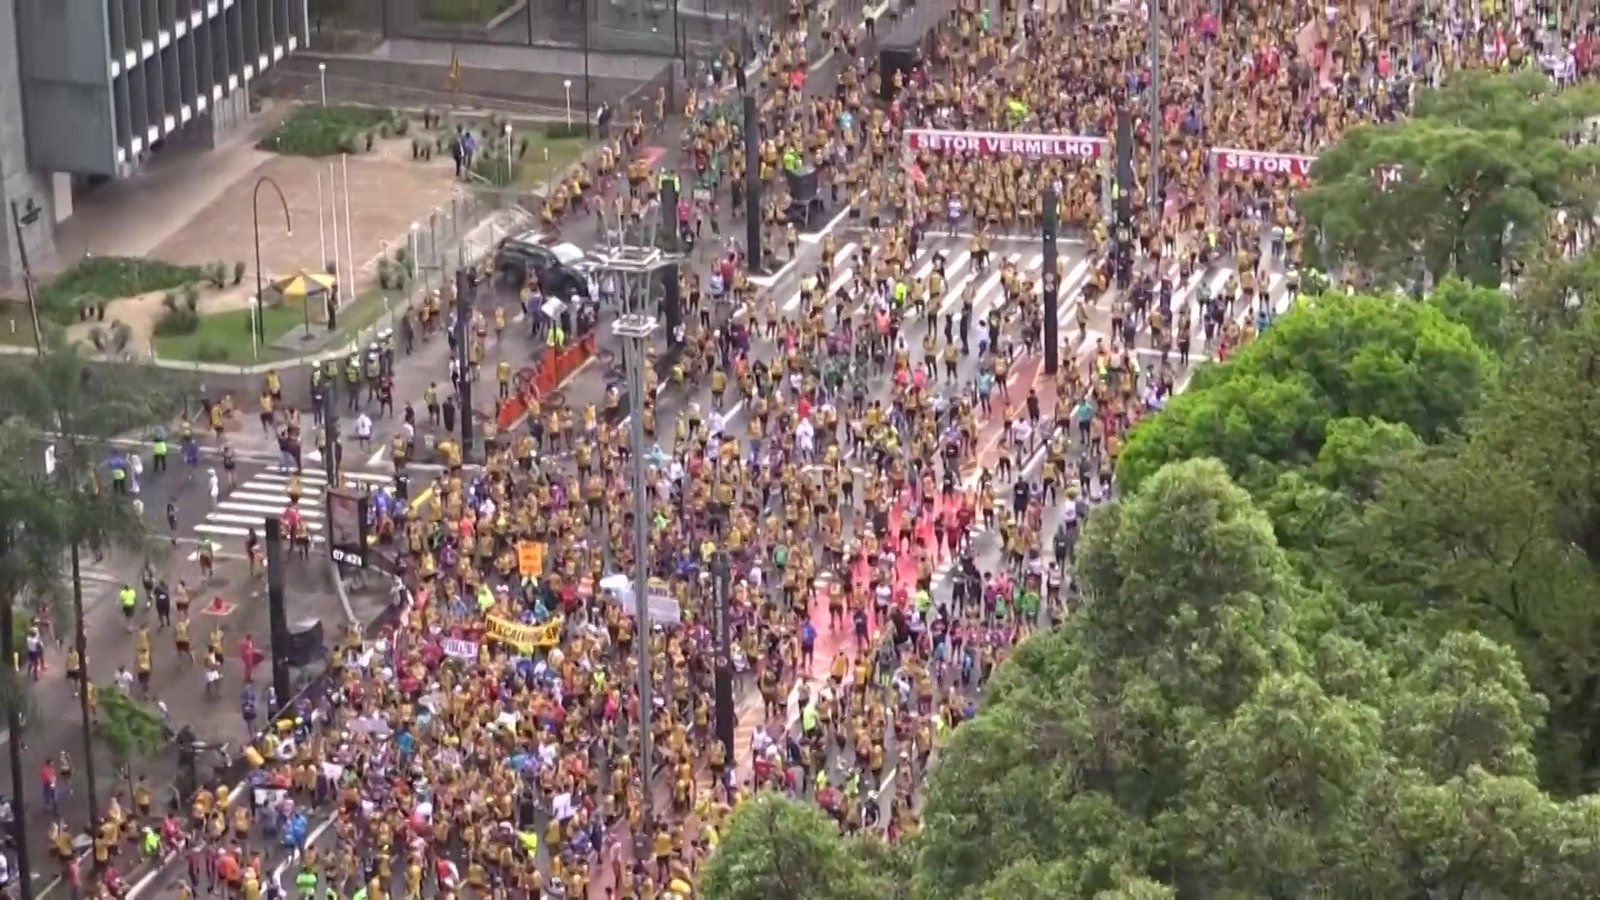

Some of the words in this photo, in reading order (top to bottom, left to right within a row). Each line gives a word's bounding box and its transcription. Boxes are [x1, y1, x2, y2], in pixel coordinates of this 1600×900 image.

[917, 135, 981, 151] SETOR
[986, 136, 1095, 157] VERMELHO
[1225, 153, 1292, 174] SETOR
